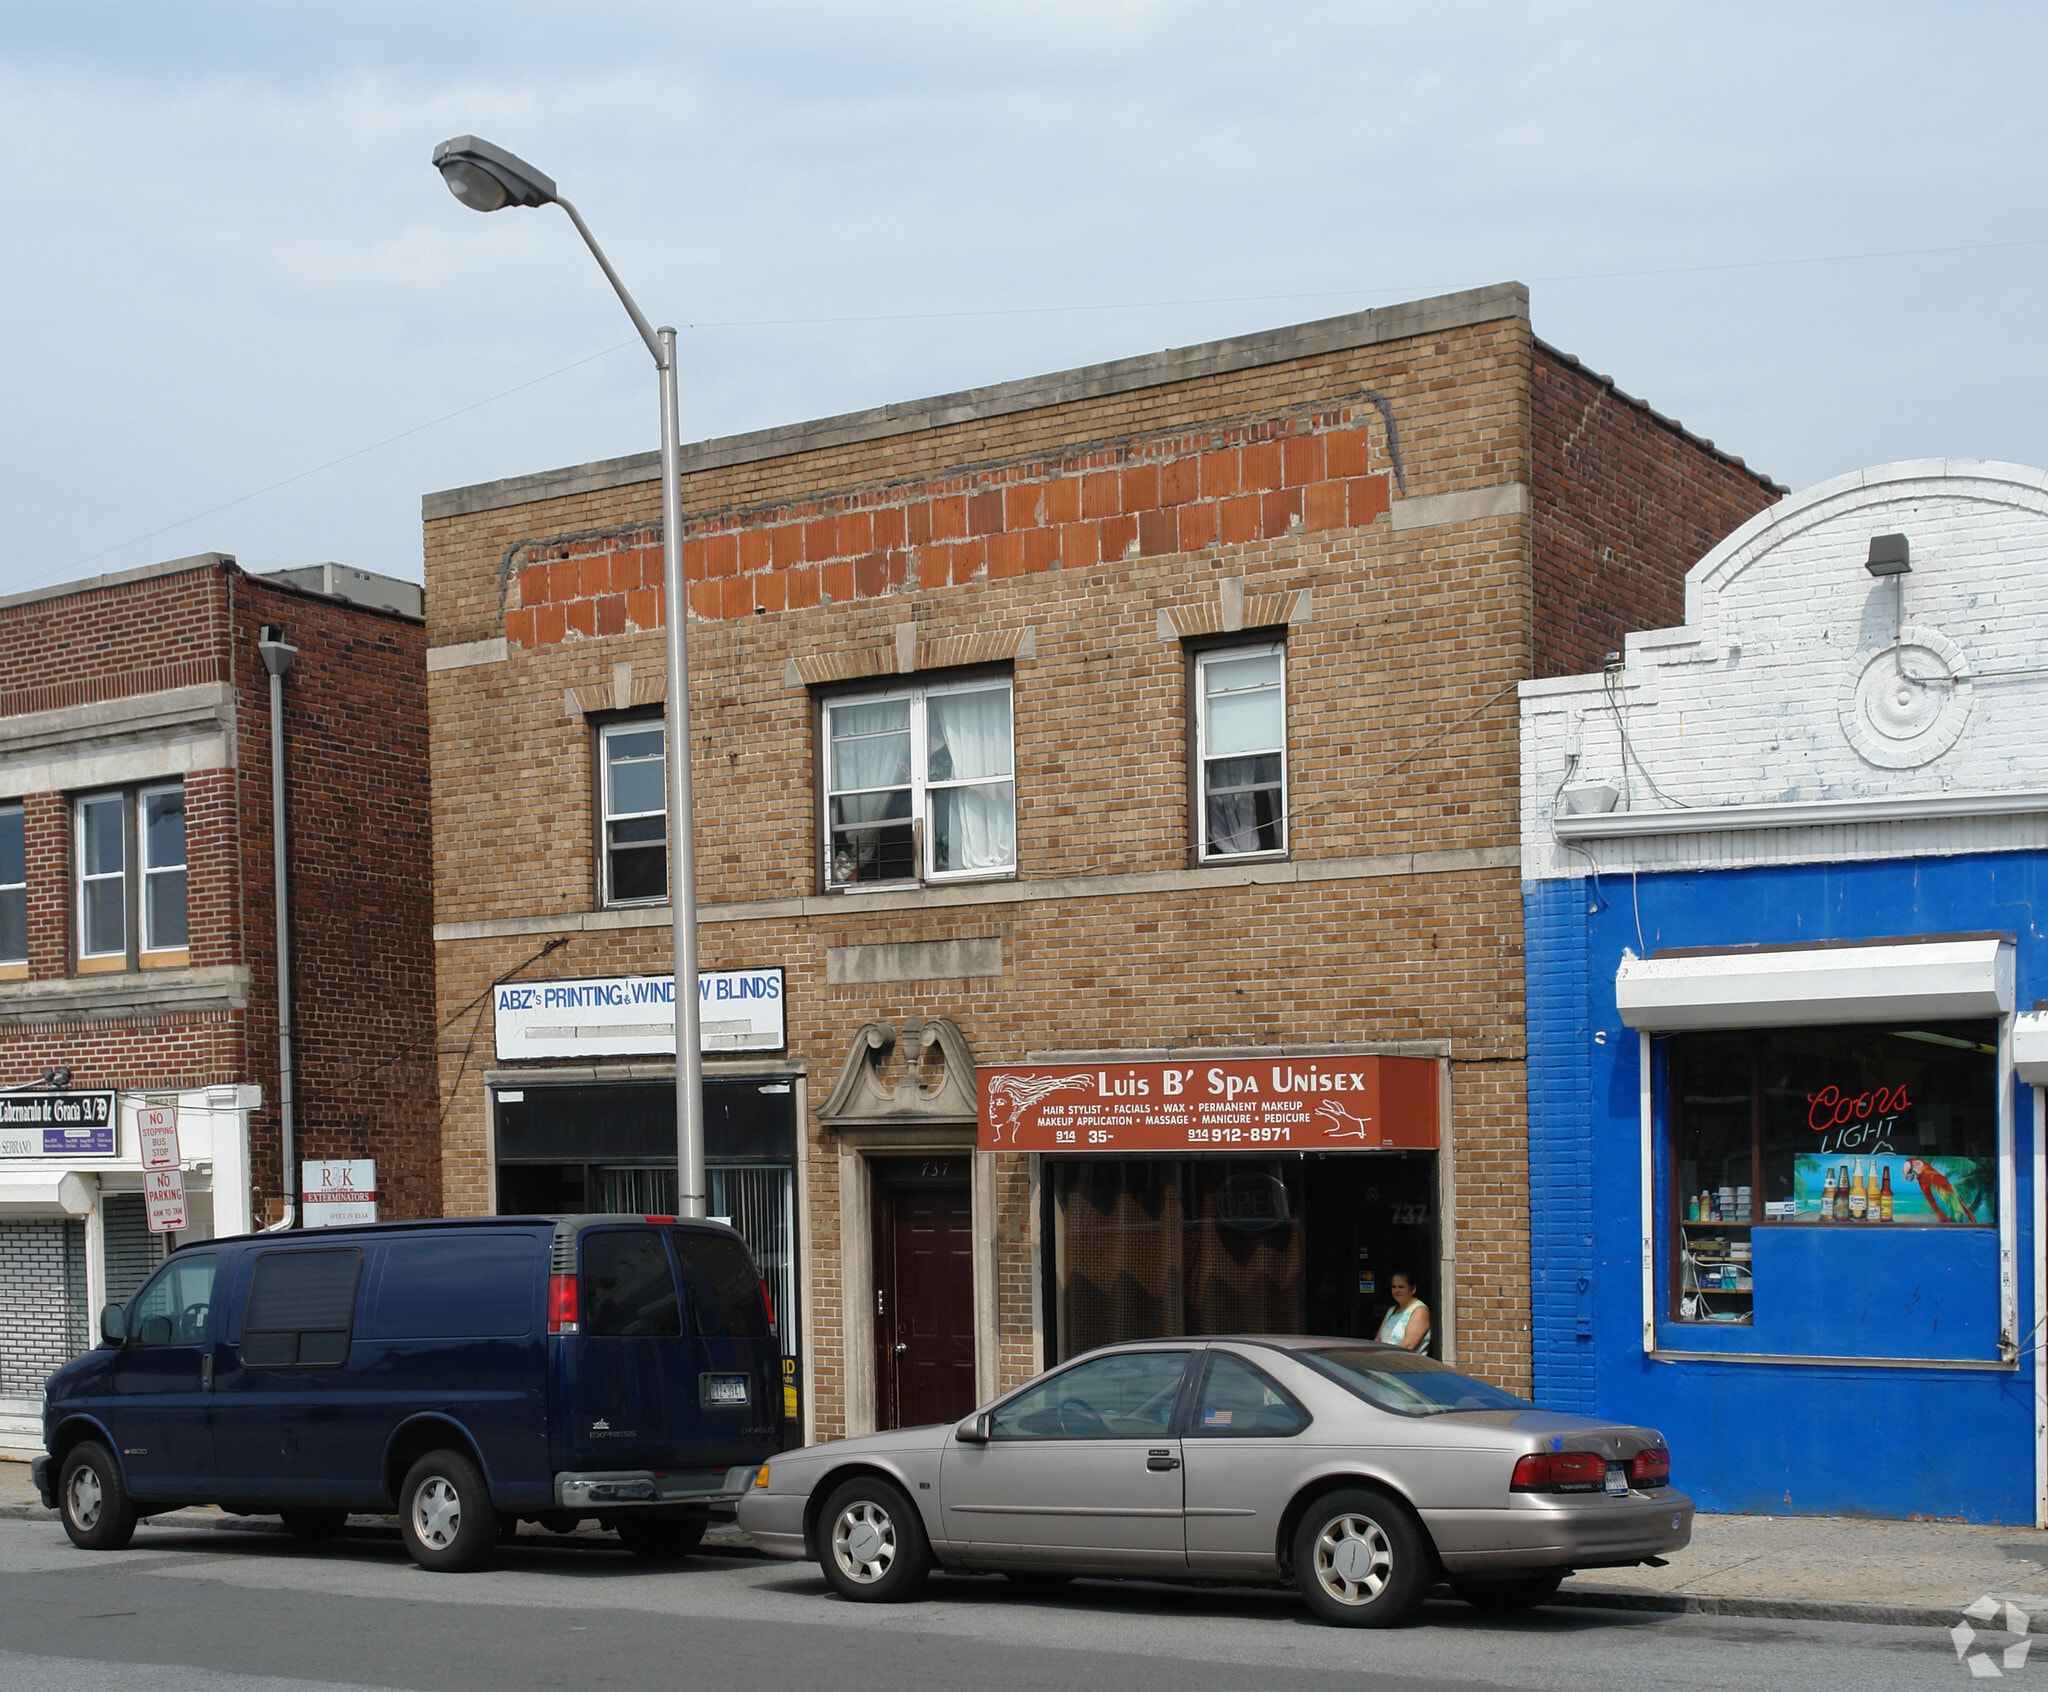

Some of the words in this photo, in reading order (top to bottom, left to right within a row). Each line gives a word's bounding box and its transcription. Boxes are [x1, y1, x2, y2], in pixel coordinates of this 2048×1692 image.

[544, 984, 623, 1008] PRINTING
[631, 979, 711, 1004] WINDW
[717, 975, 780, 1000] BLINDS
[1043, 1106, 1065, 1115] HAIR
[1068, 1105, 1102, 1115] STYLIST
[1114, 1104, 1151, 1114] FACIALS
[1163, 1103, 1185, 1113] WAX
[1198, 1102, 1257, 1112] PERMANENT
[1261, 1101, 1303, 1111] MAKEUP
[1807, 1083, 1913, 1131] Coors
[149, 1113, 164, 1125] NO
[1037, 1117, 1074, 1127] MAKEUP
[1076, 1116, 1133, 1126] APPLICATION
[1145, 1115, 1189, 1125] MASSAGE
[1201, 1114, 1251, 1124] MANICURE
[1264, 1113, 1311, 1123] PEDICURE
[142, 1126, 174, 1137] STOPPING
[1056, 1131, 1076, 1141] 914
[1188, 1129, 1209, 1140] 914
[1211, 1128, 1291, 1142] 912-8971
[1821, 1115, 1899, 1154] LIGHT
[2, 1140, 31, 1154] SERRANO
[152, 1138, 166, 1147] BUS
[151, 1147, 169, 1157] STOP
[157, 1175, 170, 1188] NO
[149, 1188, 182, 1202] PARKING
[308, 1192, 370, 1202] EXTERMINATORS
[589, 1430, 637, 1439] EXPRESS
